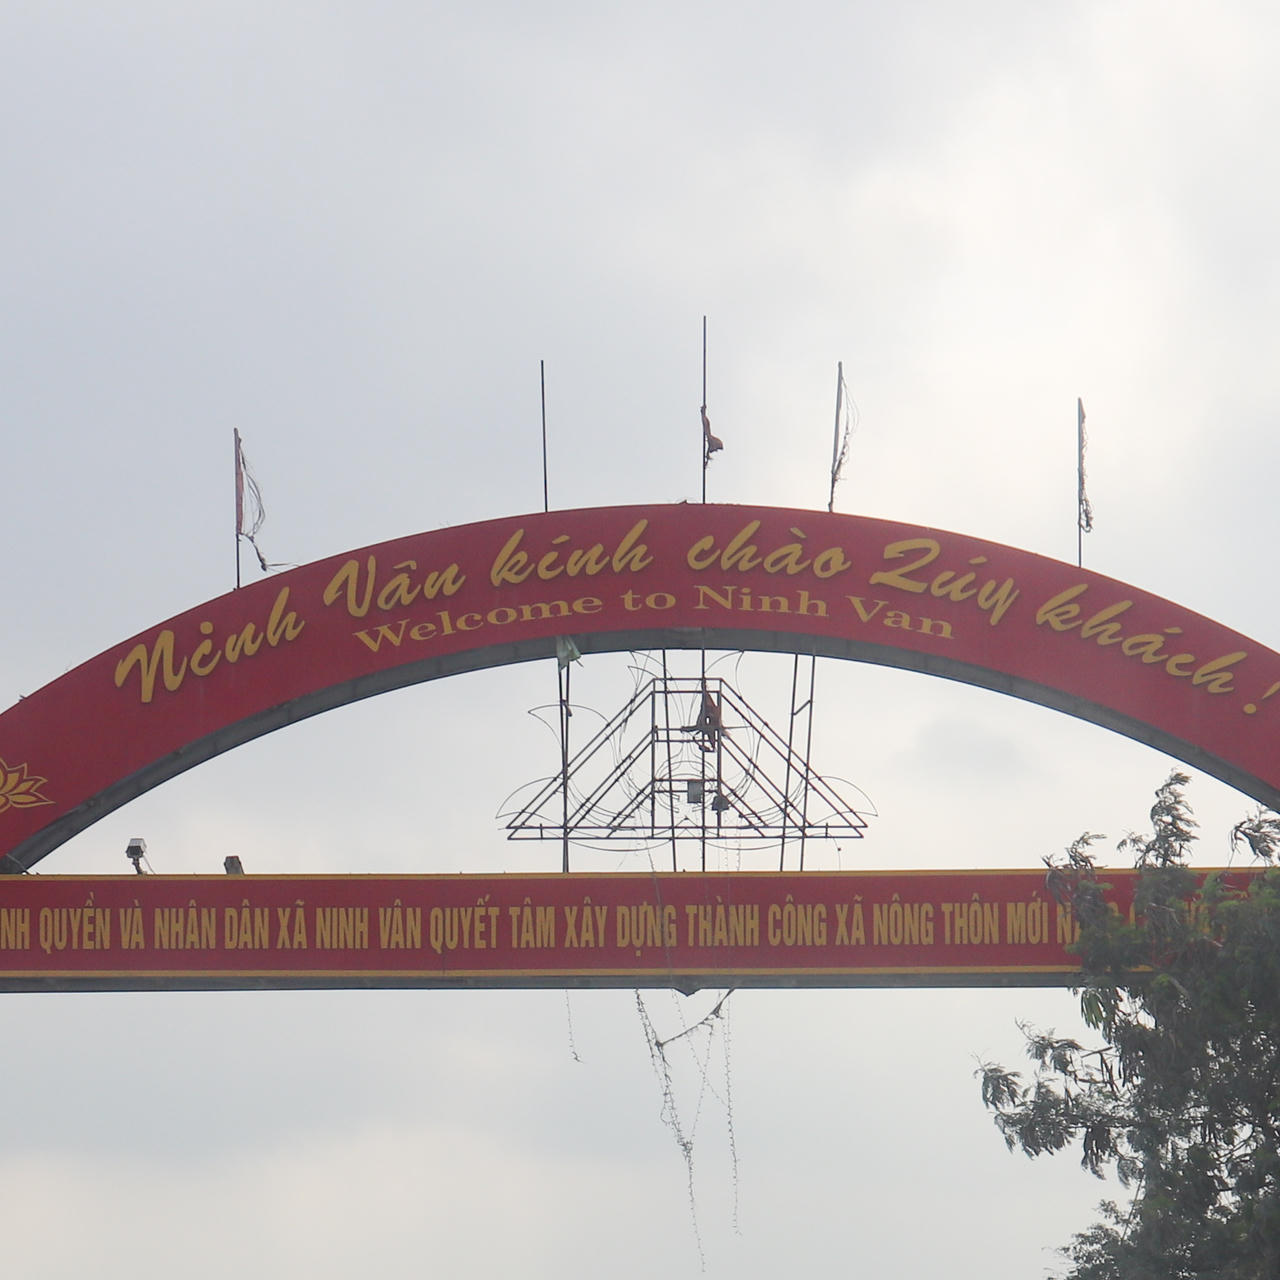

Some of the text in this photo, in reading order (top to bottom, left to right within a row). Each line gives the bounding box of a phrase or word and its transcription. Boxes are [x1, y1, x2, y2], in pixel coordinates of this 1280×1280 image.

[113, 586, 306, 704] Ninh
[323, 555, 466, 618] Vân
[489, 529, 653, 587] kính
[686, 520, 851, 579] chào
[868, 537, 1020, 626] Quý
[352, 584, 956, 654] Welcome to Ninh Van
[39, 892, 111, 955] QUYỀN
[120, 900, 145, 950] VÀ
[154, 900, 217, 950] NHÂN
[224, 900, 270, 950] DÂN
[276, 900, 308, 950] XÃ
[316, 907, 369, 949] NINH
[379, 899, 422, 950] VÂN
[429, 895, 500, 954] QUYẾT
[510, 897, 556, 949] TÂM
[564, 897, 608, 949] XÂY
[616, 901, 678, 957] DỰNG
[685, 896, 761, 948] THÀNH
[767, 895, 828, 947] CÔNG
[835, 895, 866, 945] XÃ
[873, 893, 935, 945] NÔNG
[941, 893, 1001, 945] THÔN
[1006, 891, 1050, 945] MỚI
